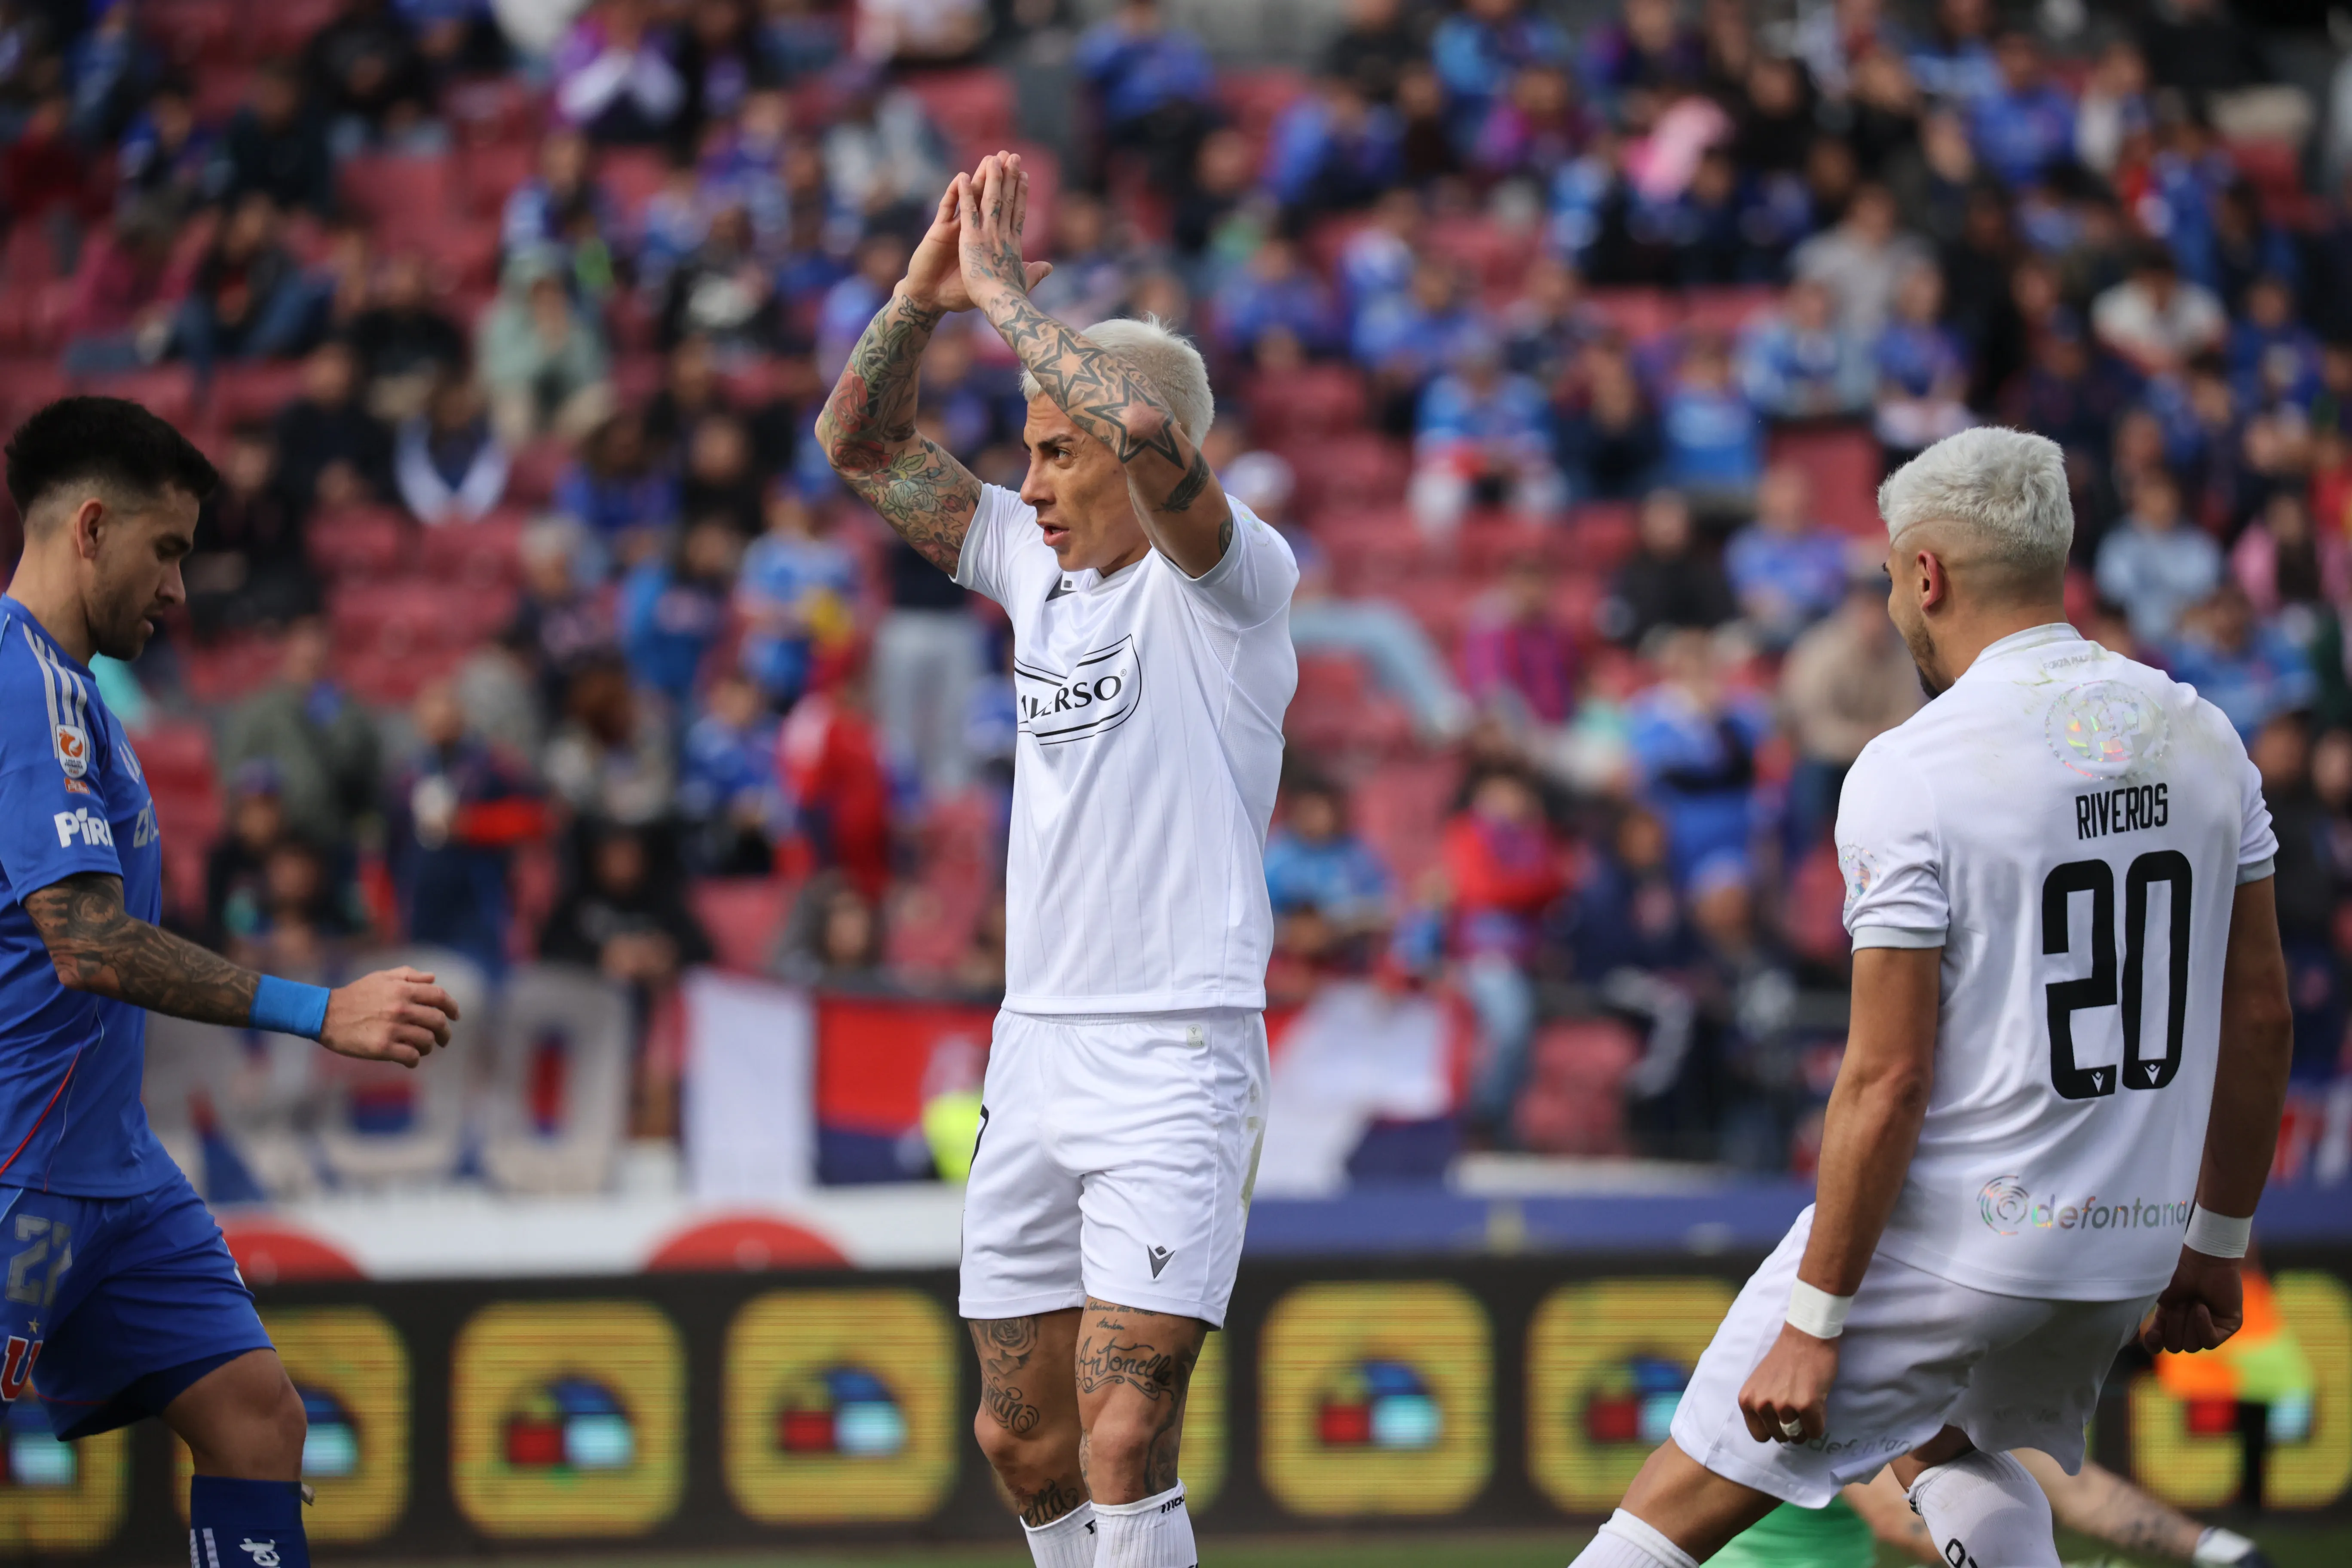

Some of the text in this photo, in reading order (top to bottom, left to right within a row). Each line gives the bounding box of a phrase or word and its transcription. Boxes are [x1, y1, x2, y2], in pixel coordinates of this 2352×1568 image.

[2076, 783, 2168, 840] RIVEROS
[2042, 850, 2193, 1099] 20
[2031, 1194, 2188, 1229] defontana
[0, 1335, 43, 1402] U
